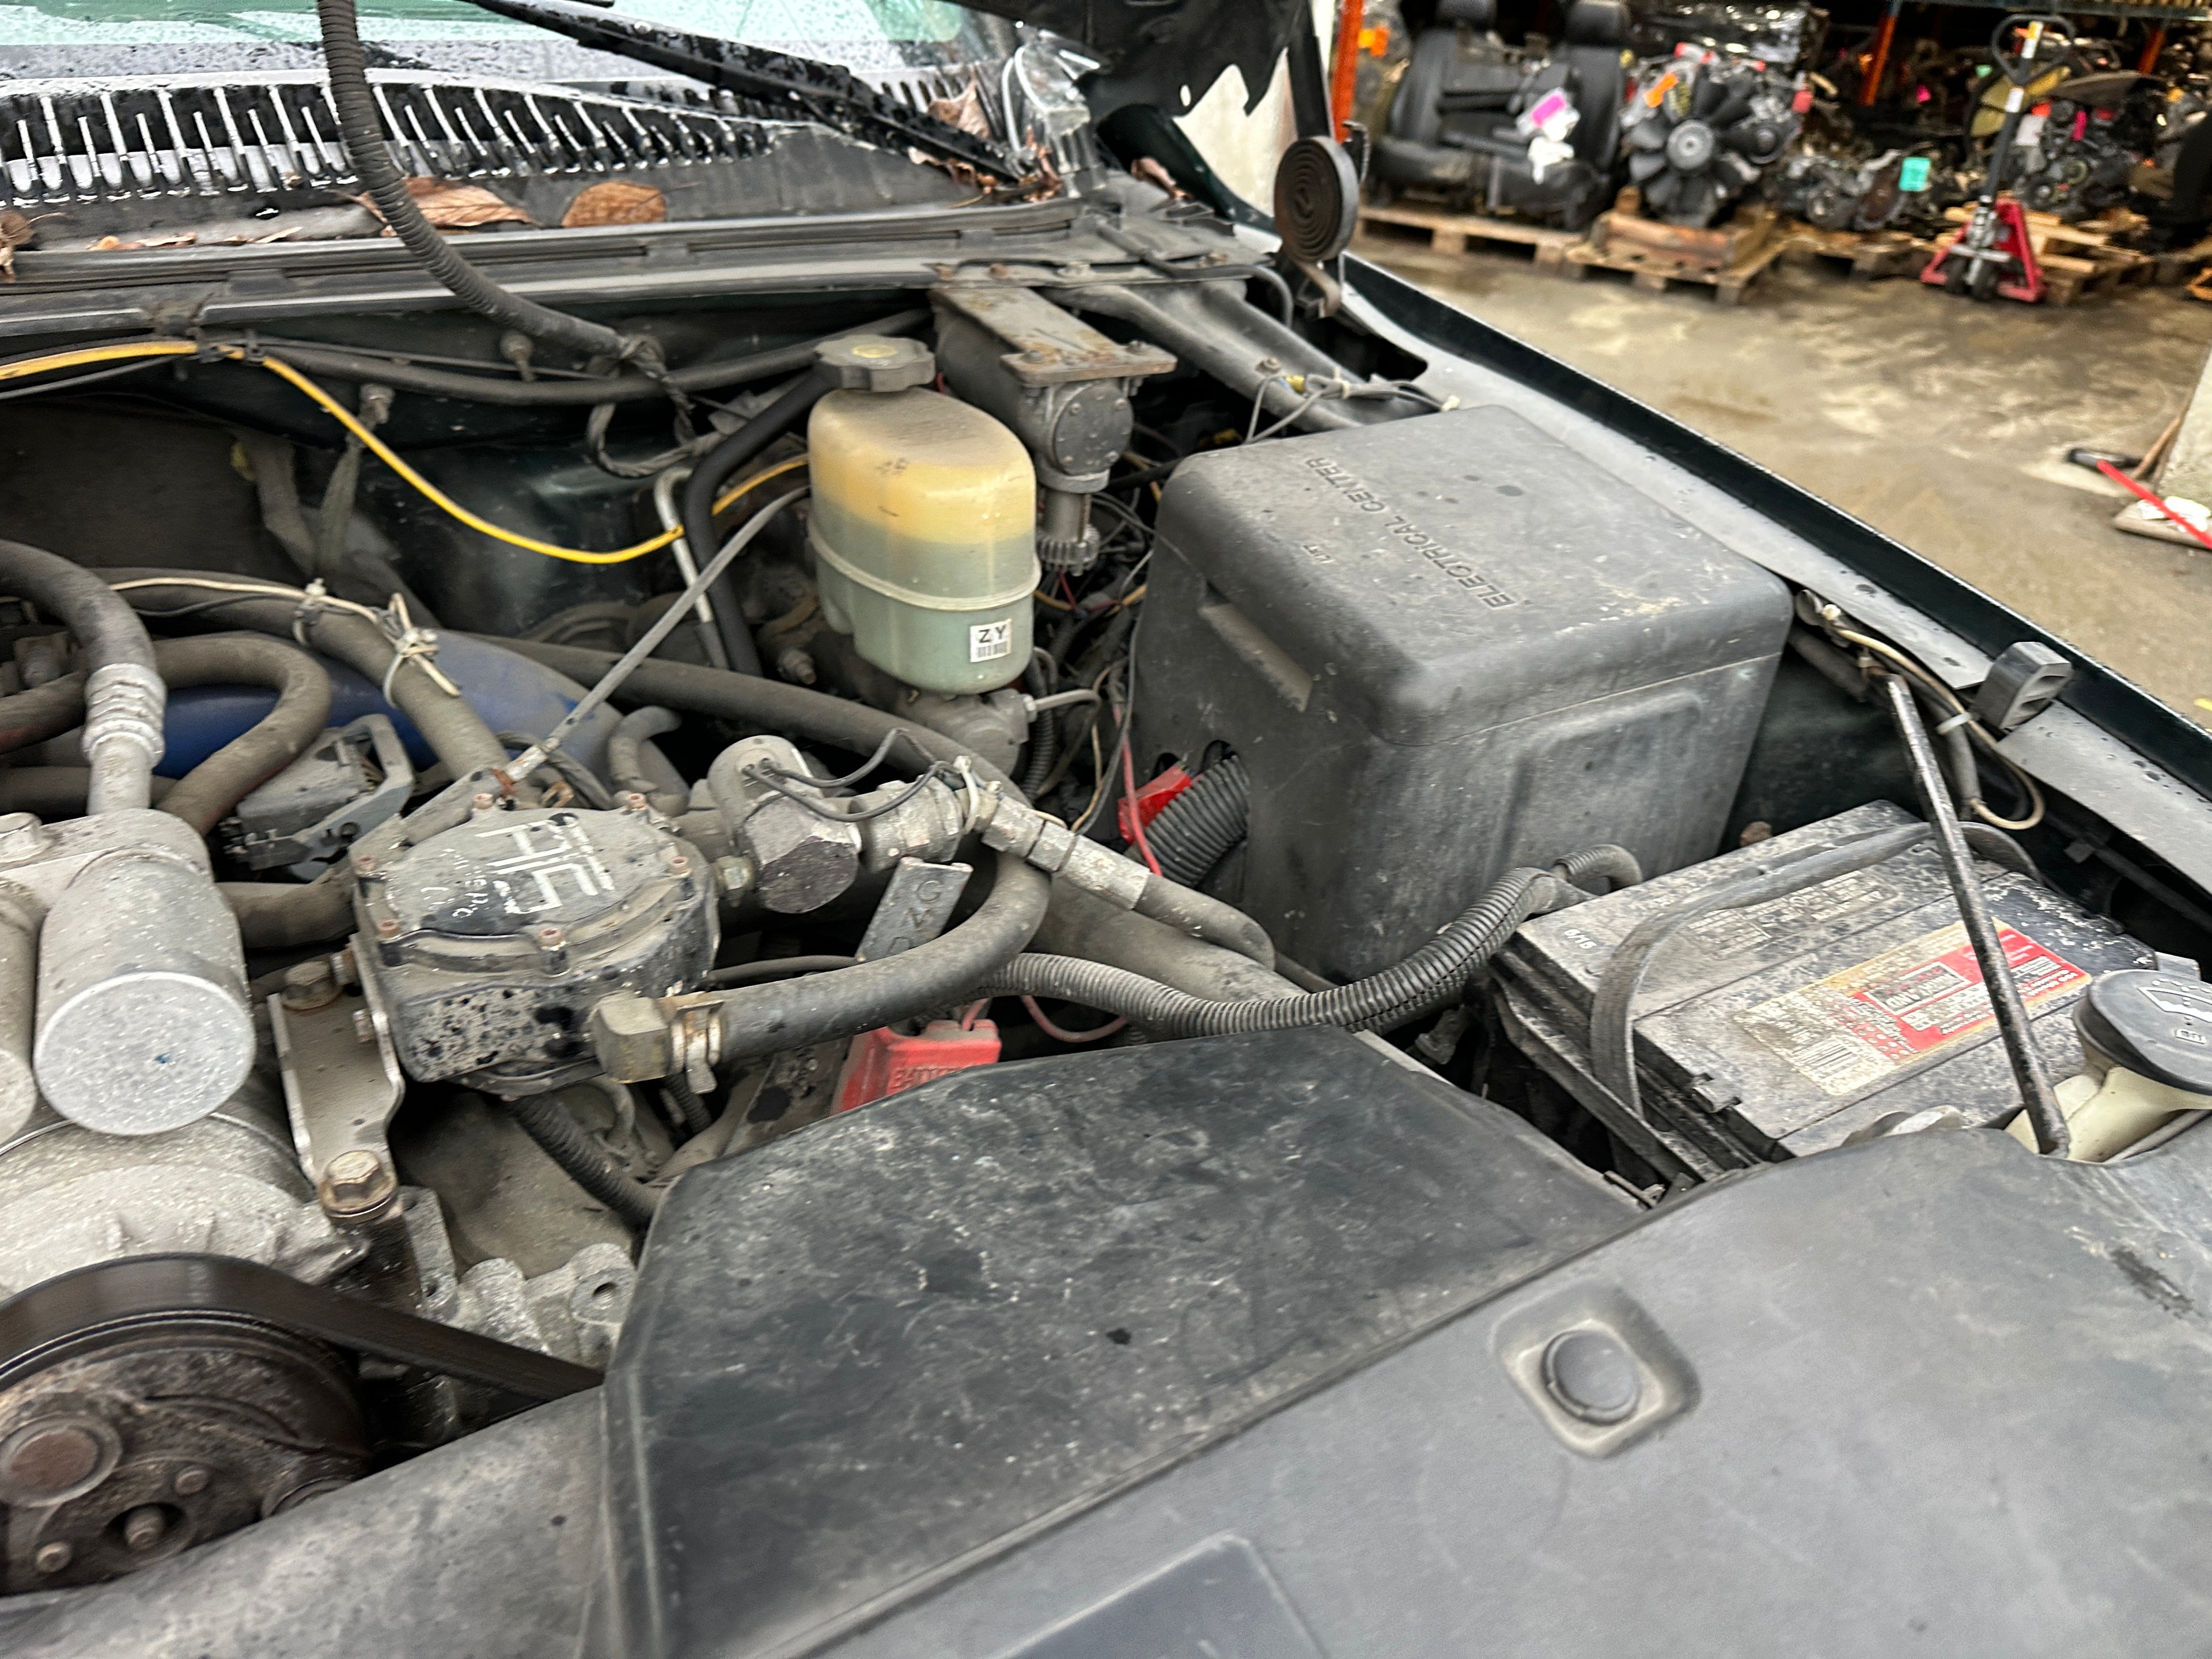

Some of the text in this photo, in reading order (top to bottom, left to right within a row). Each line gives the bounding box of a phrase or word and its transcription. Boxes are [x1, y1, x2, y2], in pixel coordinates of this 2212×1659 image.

[1305, 457, 1516, 609] ELECTRICAL CENTER
[1563, 929, 1597, 950] 6/15
